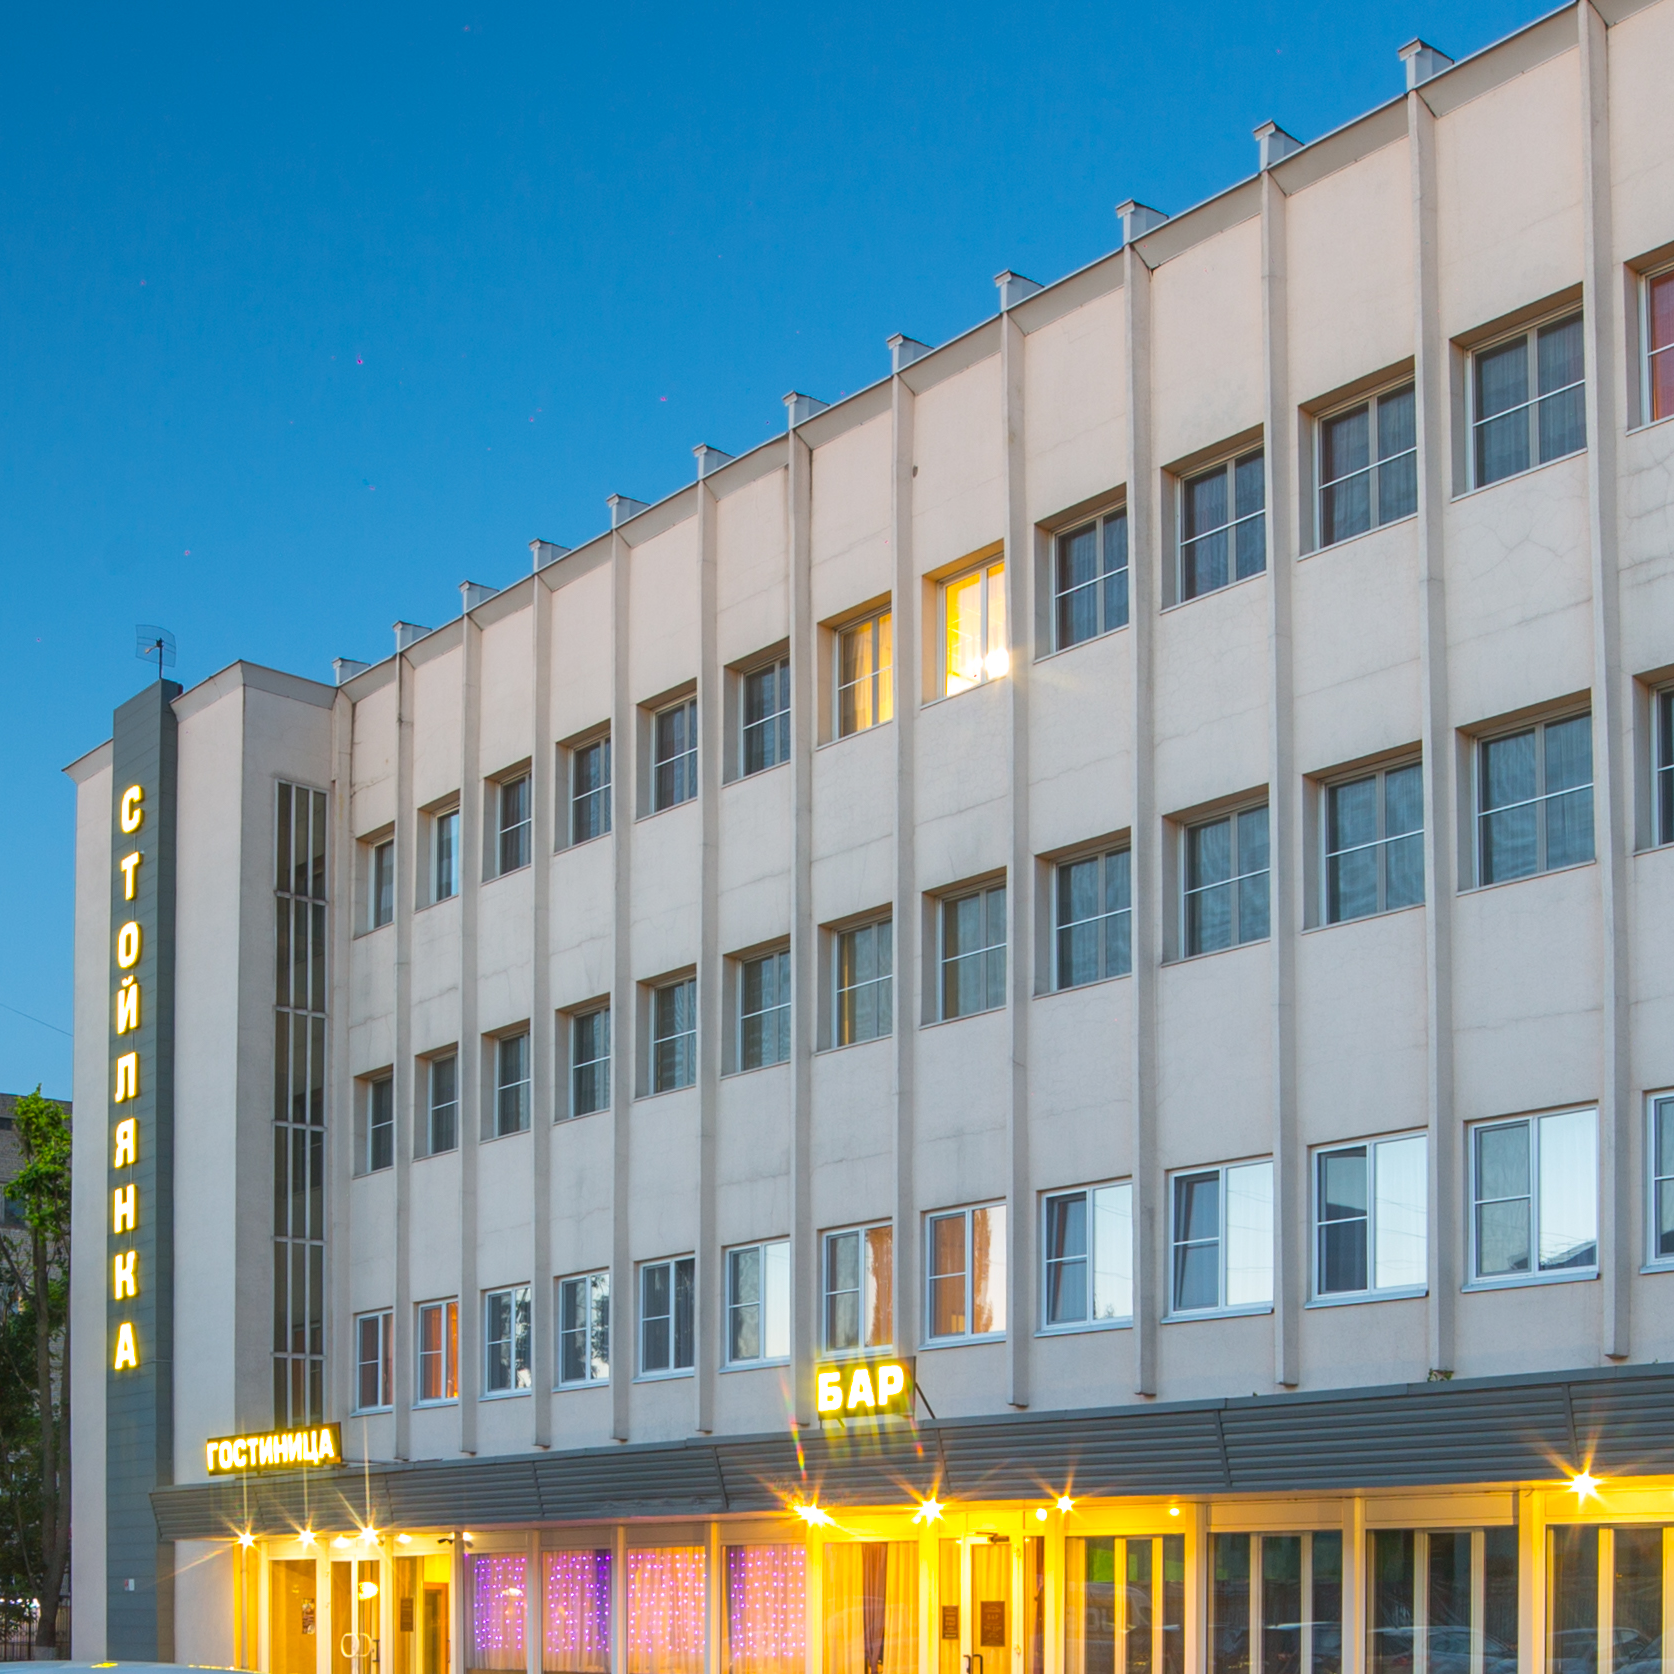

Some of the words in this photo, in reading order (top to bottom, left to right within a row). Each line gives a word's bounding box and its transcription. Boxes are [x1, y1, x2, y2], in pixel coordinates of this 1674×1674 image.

[114, 784, 144, 1370] СТОЙЛЯНКА
[817, 1364, 904, 1412] БАР
[206, 1428, 335, 1471] ГОСТИНИЦА
